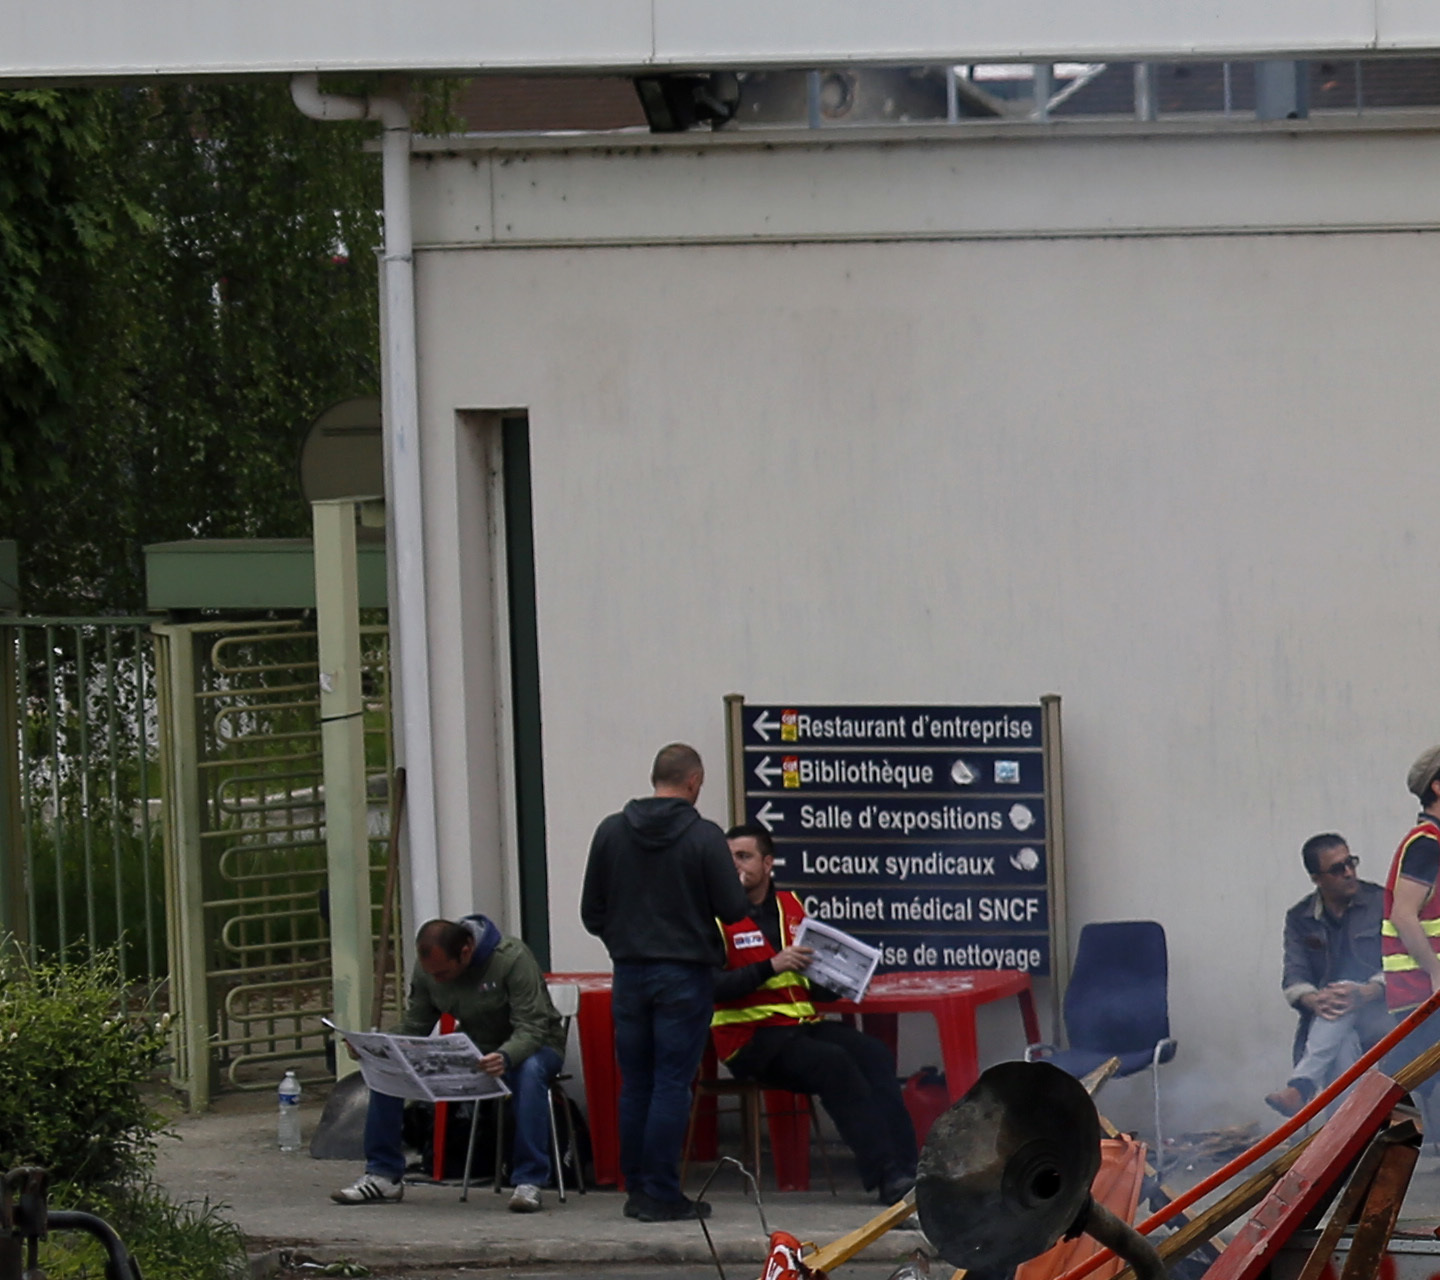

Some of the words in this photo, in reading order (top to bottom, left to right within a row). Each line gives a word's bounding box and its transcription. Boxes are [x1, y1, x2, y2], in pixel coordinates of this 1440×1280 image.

[797, 714, 906, 738] Restaurant
[912, 716, 1033, 743] d'entreprise
[800, 760, 934, 789] Bibliothèque
[800, 806, 851, 829] Salle
[859, 806, 1002, 834] d'expositions
[802, 851, 879, 874] Locaux
[885, 852, 995, 880] syndicaux
[803, 896, 884, 920] Cabinet
[890, 897, 972, 921] médical
[978, 898, 1039, 921] SNCF
[914, 943, 938, 966] de
[943, 944, 1041, 972] nettoyage
